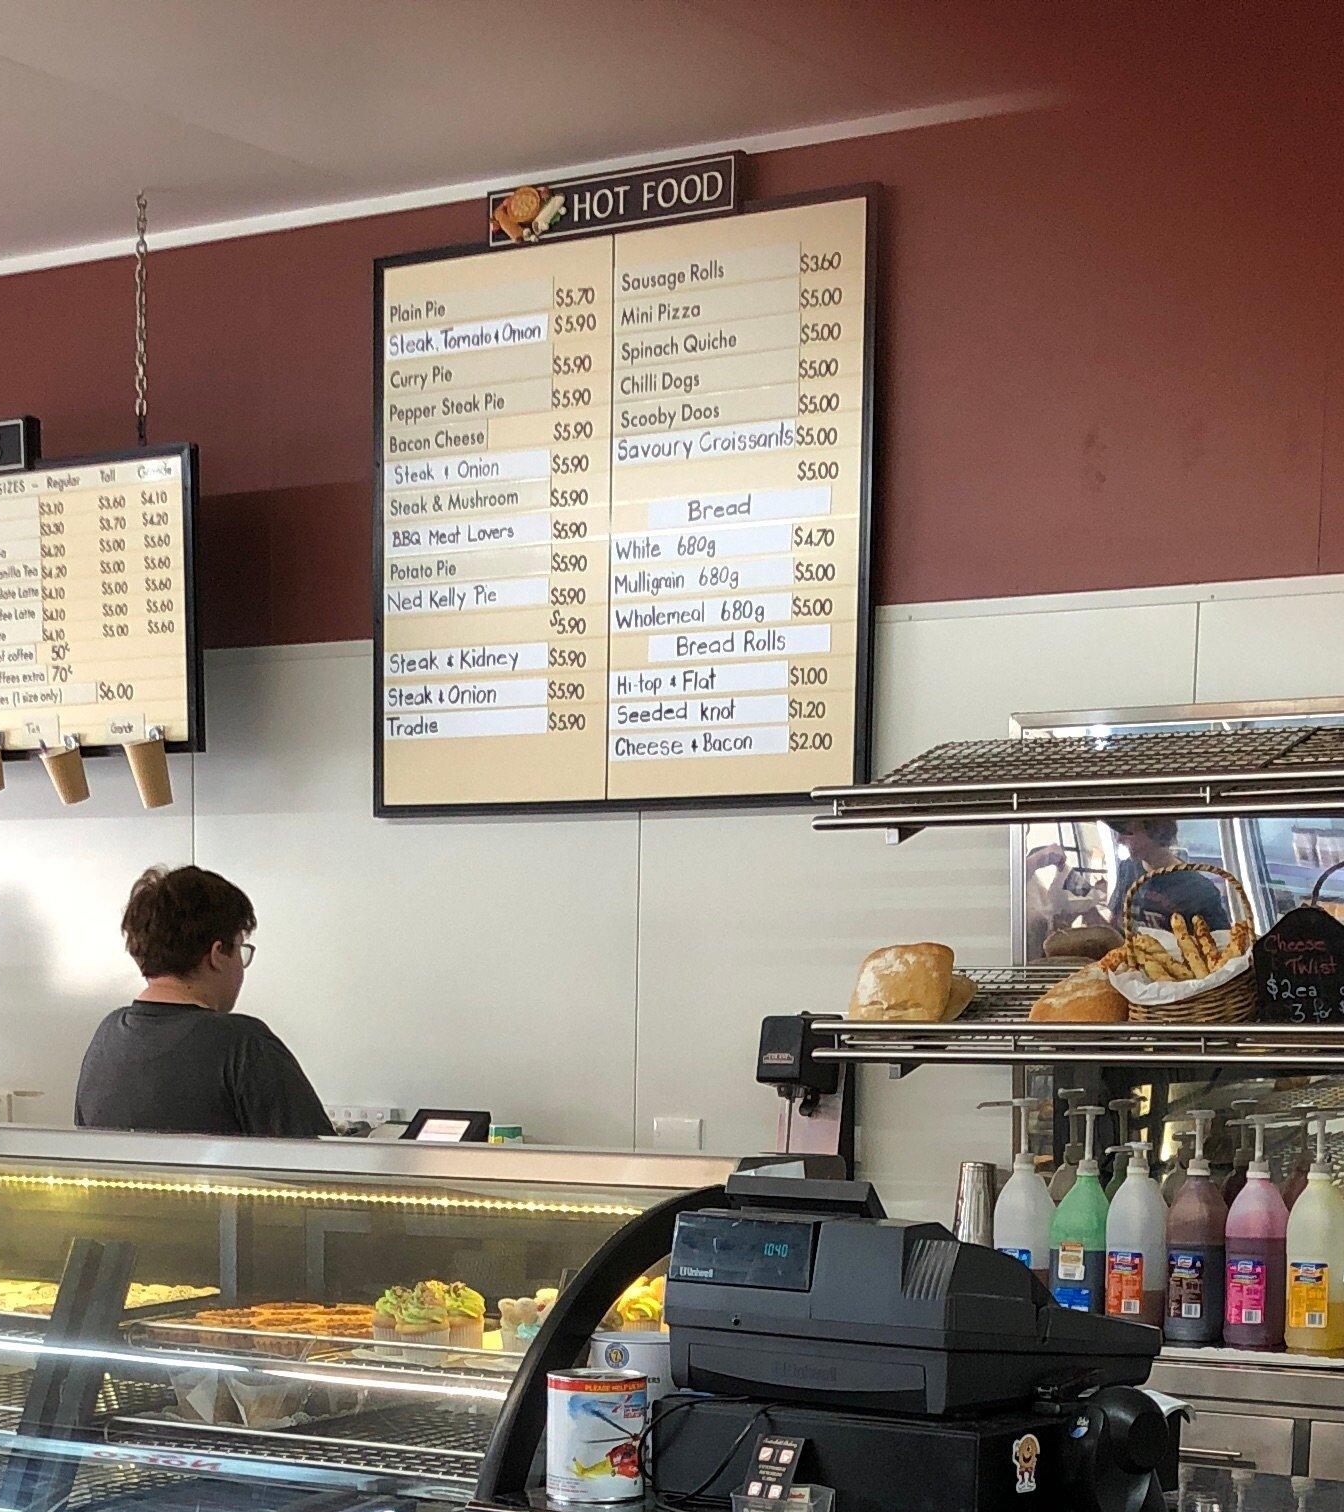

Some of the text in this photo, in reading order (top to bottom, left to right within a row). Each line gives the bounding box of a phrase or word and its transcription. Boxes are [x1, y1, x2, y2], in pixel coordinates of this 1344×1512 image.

[574, 172, 722, 222] HOT FOOD
[621, 252, 842, 291] Sausage Rolls $3.60
[390, 287, 595, 322] Plain Pie $5.70
[621, 288, 842, 326] Mini Pizza $5.00
[502, 323, 541, 340] Onion
[555, 313, 596, 334] $5.90
[621, 322, 841, 364] Spinach Quiche $5.00
[390, 354, 592, 390] Curry Pie $5.90
[621, 358, 838, 395] Chilli Dogs $5.00
[389, 388, 591, 425] Pepper Steak Pie $5.90
[621, 393, 840, 429] Scooby Doos $5.00
[389, 421, 593, 453] Bacon Cheese $5.90
[617, 422, 837, 461] Savoury Croissants $5.00
[47, 474, 80, 492] Regular
[100, 469, 115, 482] Tall
[394, 463, 434, 484] Steak
[458, 457, 499, 478] Onion
[552, 454, 589, 474] $5.90
[797, 460, 838, 481] $5.00
[390, 489, 588, 516] Steak & Mushroom $5.90
[688, 494, 751, 521] Bread
[392, 521, 587, 547] BBQ Meat Lovers $5.90
[616, 526, 835, 560] White 680g $4.70
[23, 564, 38, 577] Tea
[390, 553, 587, 580] Potato Pie $5.90
[699, 566, 738, 589] 680g
[794, 562, 835, 582] $5.00
[387, 584, 586, 612] Ned Kelly Pie $5.90
[550, 609, 586, 634] $5.90
[616, 598, 833, 629] Wholemeal 680g $5.00
[7, 649, 33, 661] coffee
[676, 629, 786, 656] Bread Rolls
[390, 650, 438, 673] Steak
[460, 646, 519, 671] Kidney
[549, 647, 586, 668] $5.90
[23, 671, 45, 682] extra
[617, 675, 662, 695] Hi-top
[683, 668, 716, 691] Flat
[790, 667, 828, 685] $1.00
[23, 693, 38, 704] size
[40, 688, 63, 703] only)
[99, 682, 133, 700] $6.00
[388, 686, 433, 706] Steak
[448, 685, 496, 703] Onion
[548, 681, 585, 700] $5.90
[387, 712, 585, 736] Tradie $5.90
[617, 698, 826, 724] Seeded knot $1.20
[615, 737, 683, 756] Cheese
[703, 733, 752, 752] Bacon
[790, 732, 832, 752] $2.00
[1264, 934, 1326, 951] Cheese
[1290, 1004, 1306, 1023] 3
[764, 1243, 789, 1257] 1040
